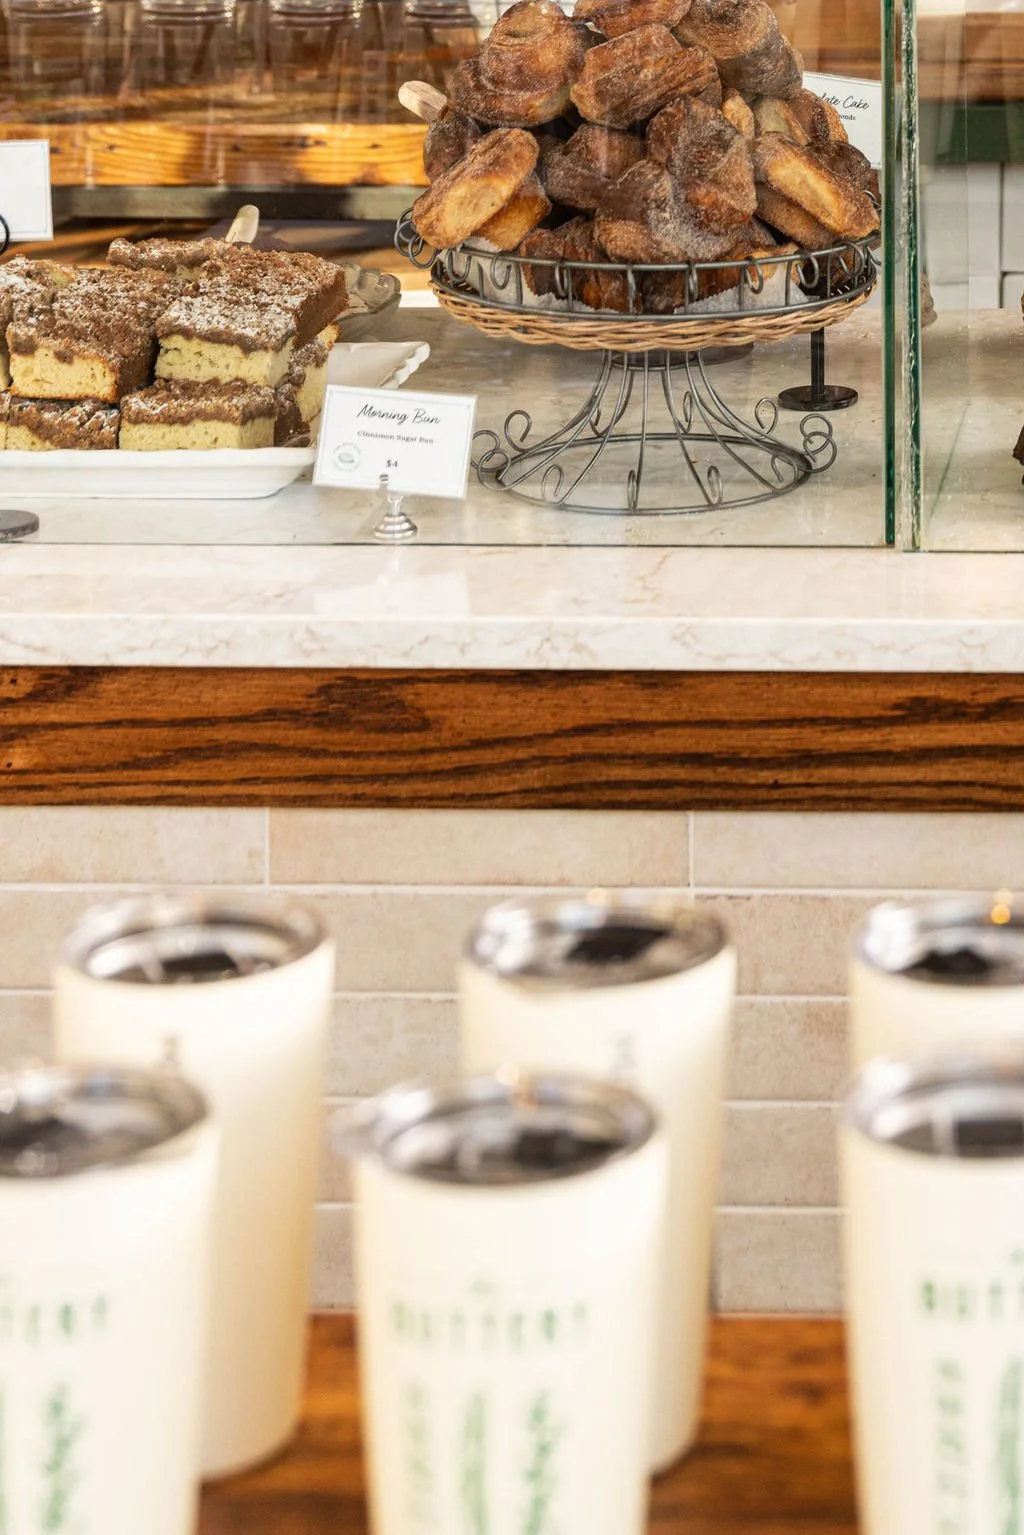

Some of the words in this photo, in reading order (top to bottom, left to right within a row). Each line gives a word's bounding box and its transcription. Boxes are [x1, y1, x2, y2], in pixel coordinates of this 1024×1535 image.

[842, 95, 869, 110] Cake
[356, 403, 408, 426] Morning
[412, 408, 442, 425] Bun
[396, 434, 417, 443] Sugar
[386, 459, 398, 468] $4
